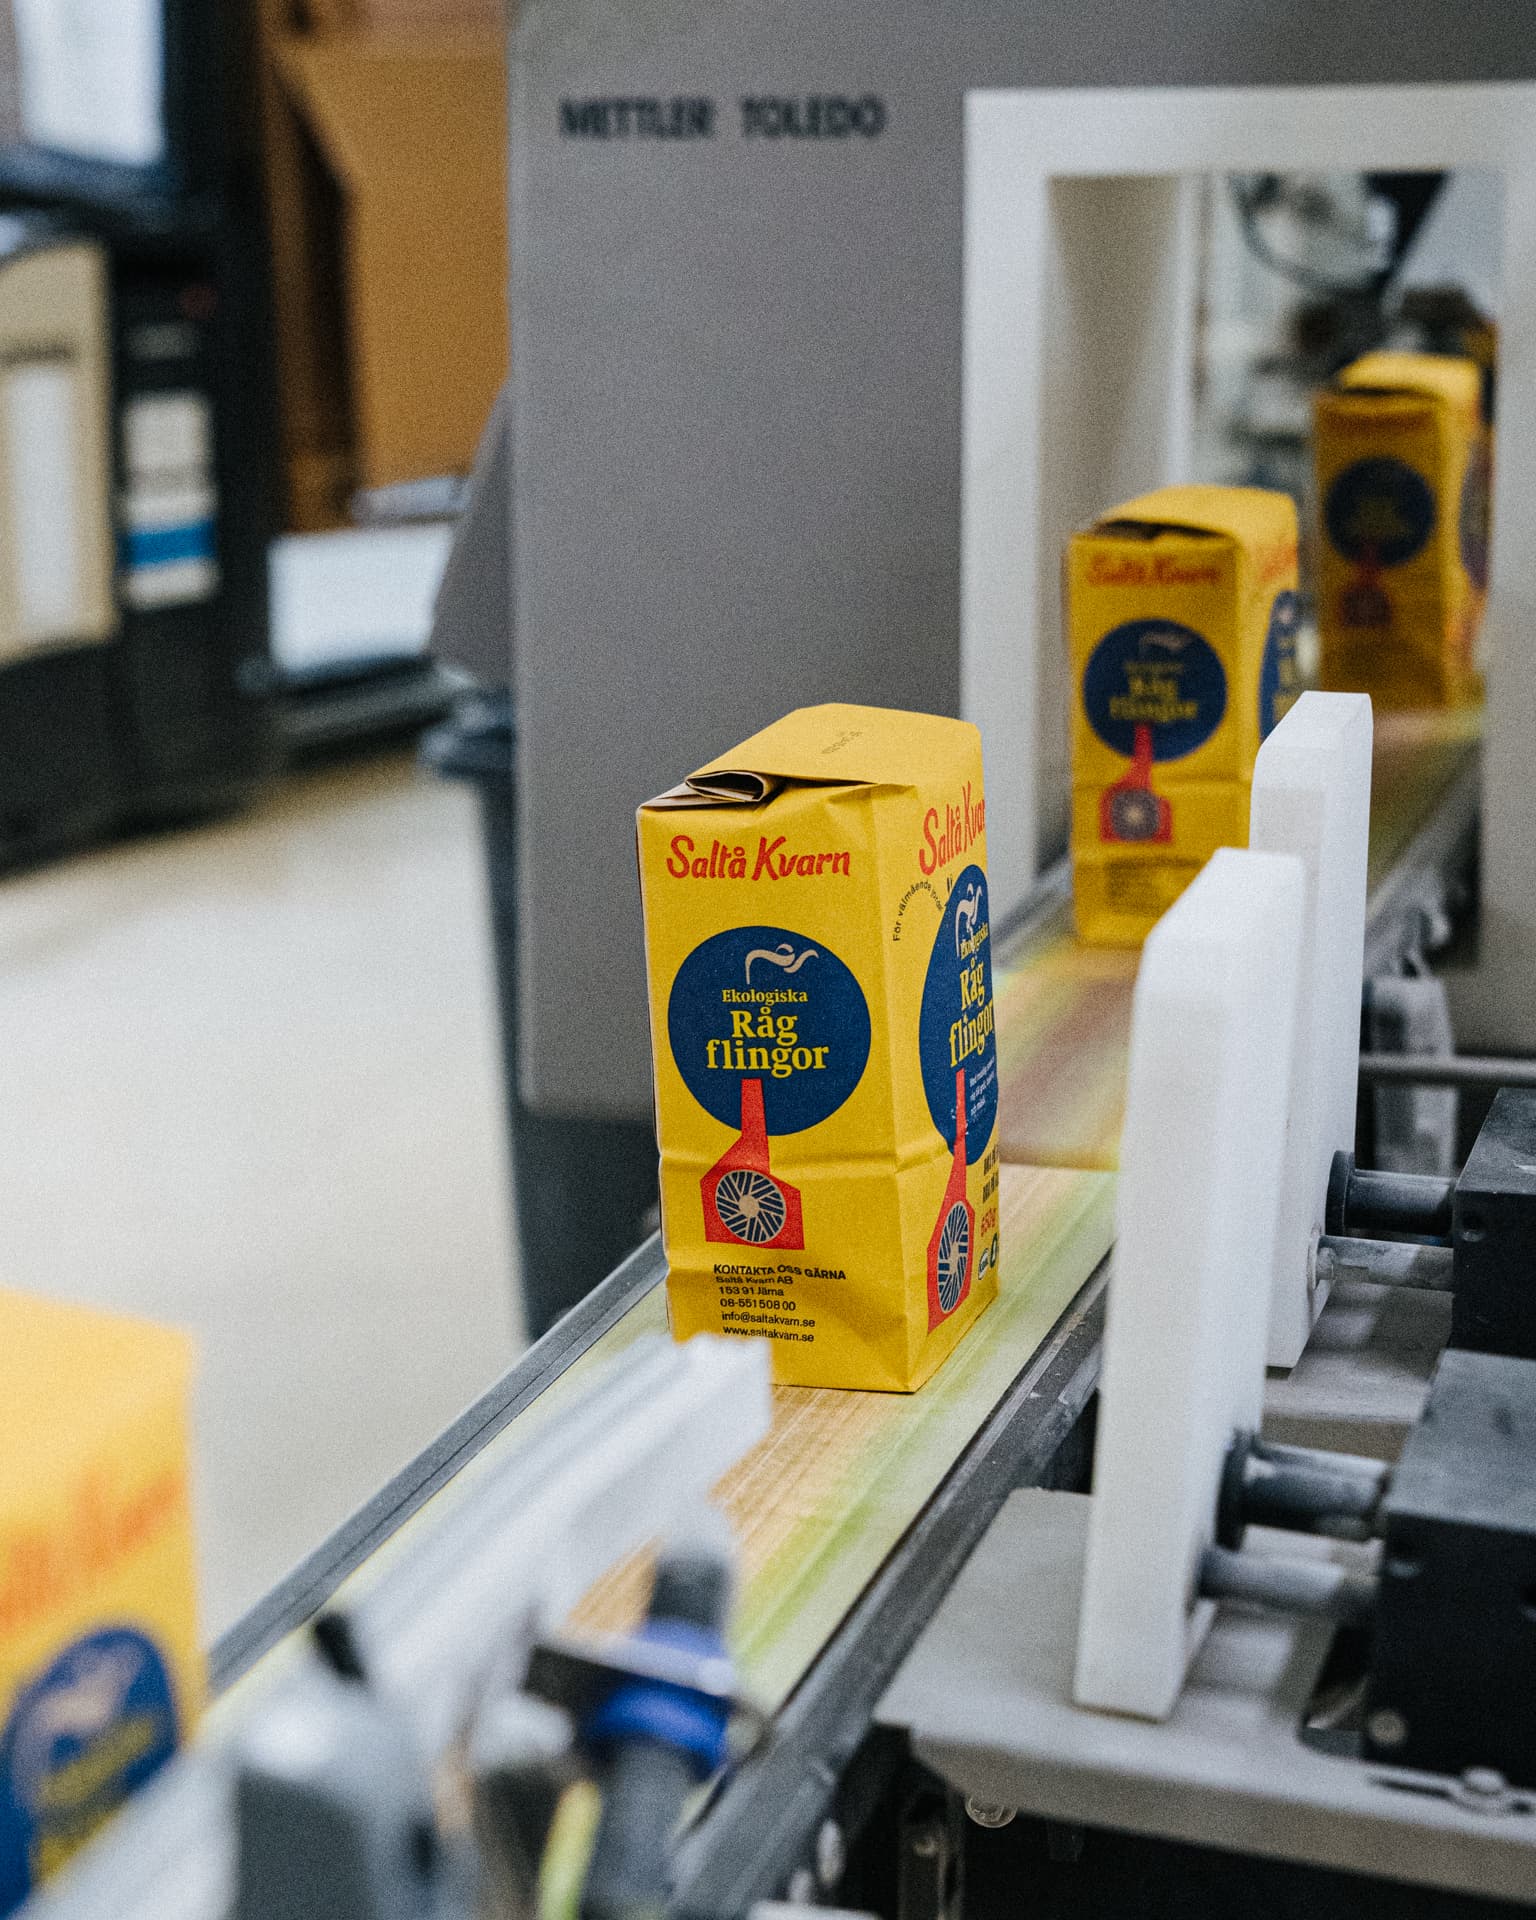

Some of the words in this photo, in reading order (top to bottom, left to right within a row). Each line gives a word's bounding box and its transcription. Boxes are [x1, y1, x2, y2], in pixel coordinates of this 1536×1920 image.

[744, 97, 884, 137] TOLEDO
[918, 804, 962, 876] Saltå
[666, 835, 746, 879] Saltå
[752, 836, 850, 881] Kvarn
[892, 921, 902, 941] För
[960, 957, 985, 1010] Råg
[722, 989, 808, 1006] Ekologiska
[730, 1006, 798, 1046] Råg
[706, 1039, 829, 1078] flingor
[713, 1264, 775, 1276] KONTAKTA
[777, 1264, 802, 1275] OSS
[804, 1267, 846, 1280] GÄRNA
[776, 1276, 794, 1285] AB
[720, 1286, 740, 1295] 153
[742, 1286, 755, 1295] 91
[757, 1286, 784, 1297] Järna
[782, 1300, 796, 1311] 00
[721, 1311, 816, 1327] info@saltakvarn.se
[723, 1326, 815, 1342] www.saltakvarn.se
